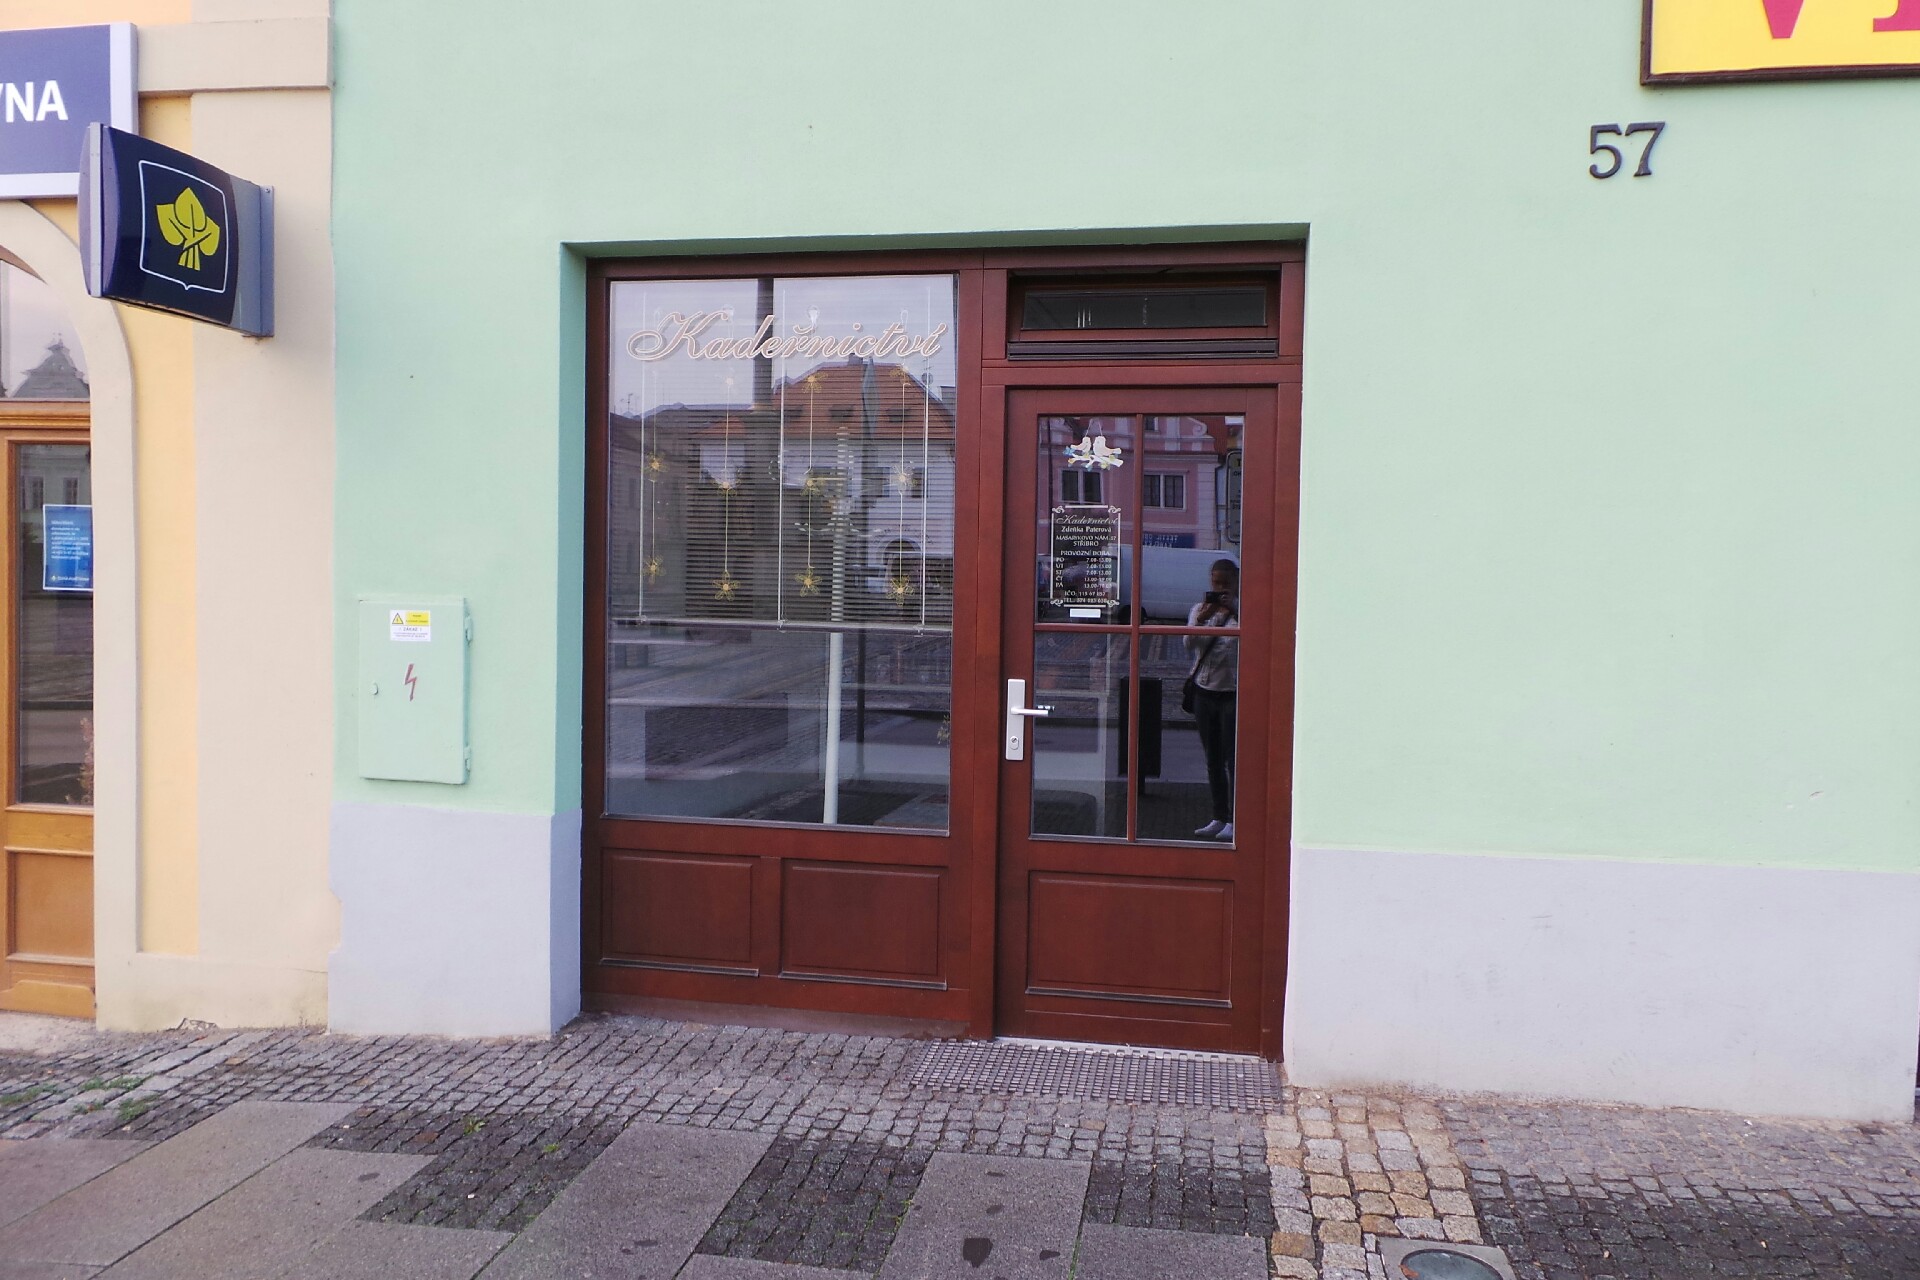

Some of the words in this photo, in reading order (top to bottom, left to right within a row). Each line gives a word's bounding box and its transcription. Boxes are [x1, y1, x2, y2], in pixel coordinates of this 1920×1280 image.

[0, 79, 69, 123] NA
[1589, 121, 1666, 179] 57
[626, 309, 948, 361] Kadeřnictví
